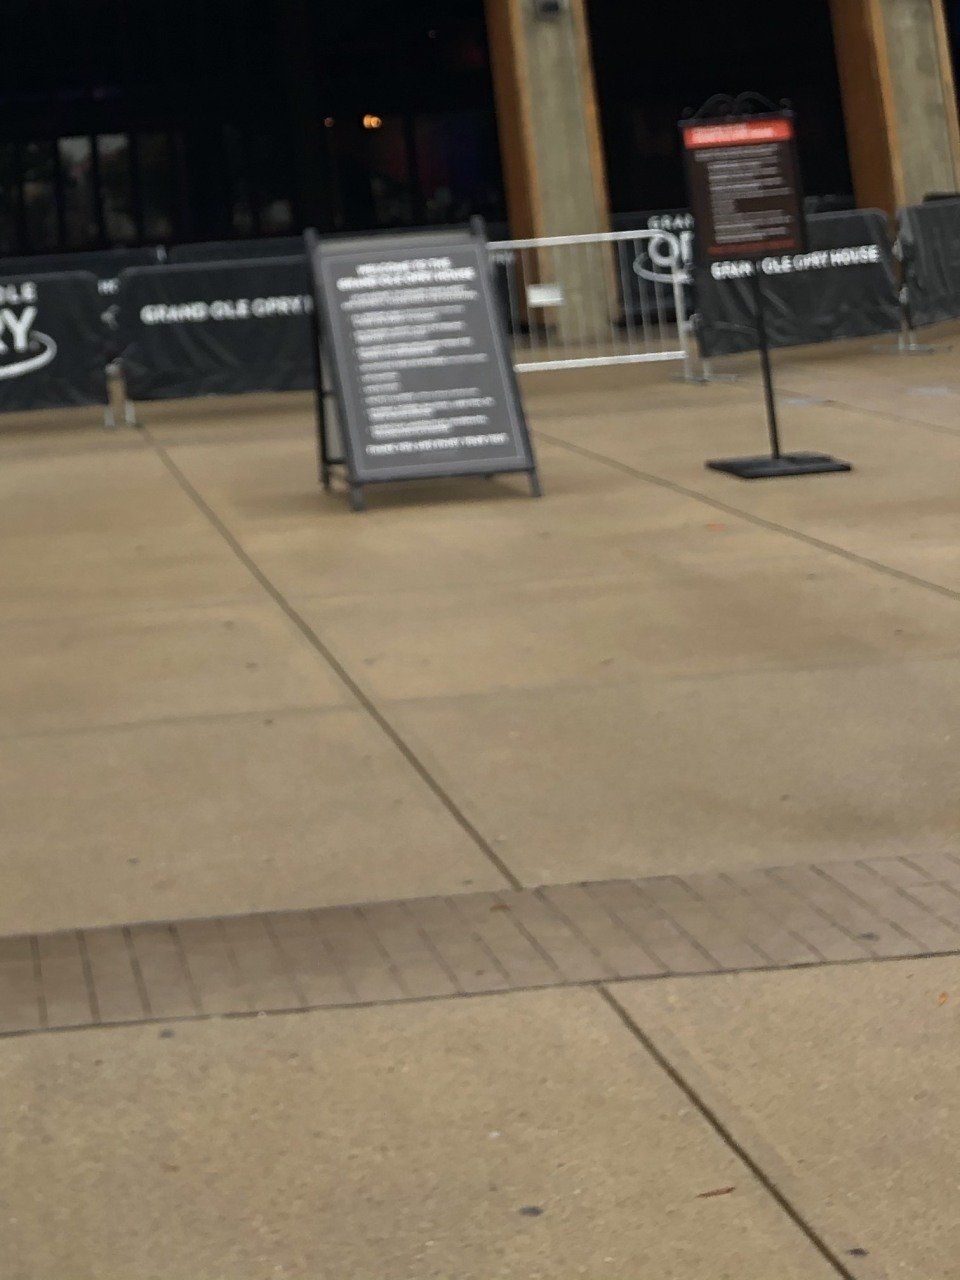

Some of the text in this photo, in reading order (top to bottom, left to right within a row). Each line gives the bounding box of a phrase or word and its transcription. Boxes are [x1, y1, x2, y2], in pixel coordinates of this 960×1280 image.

[648, 213, 695, 231] GRAN
[710, 245, 880, 281] GRAN OLE OPRY HOUSE
[140, 301, 209, 326] GRAND
[209, 298, 251, 321] OLE
[251, 294, 303, 319] OPRY
